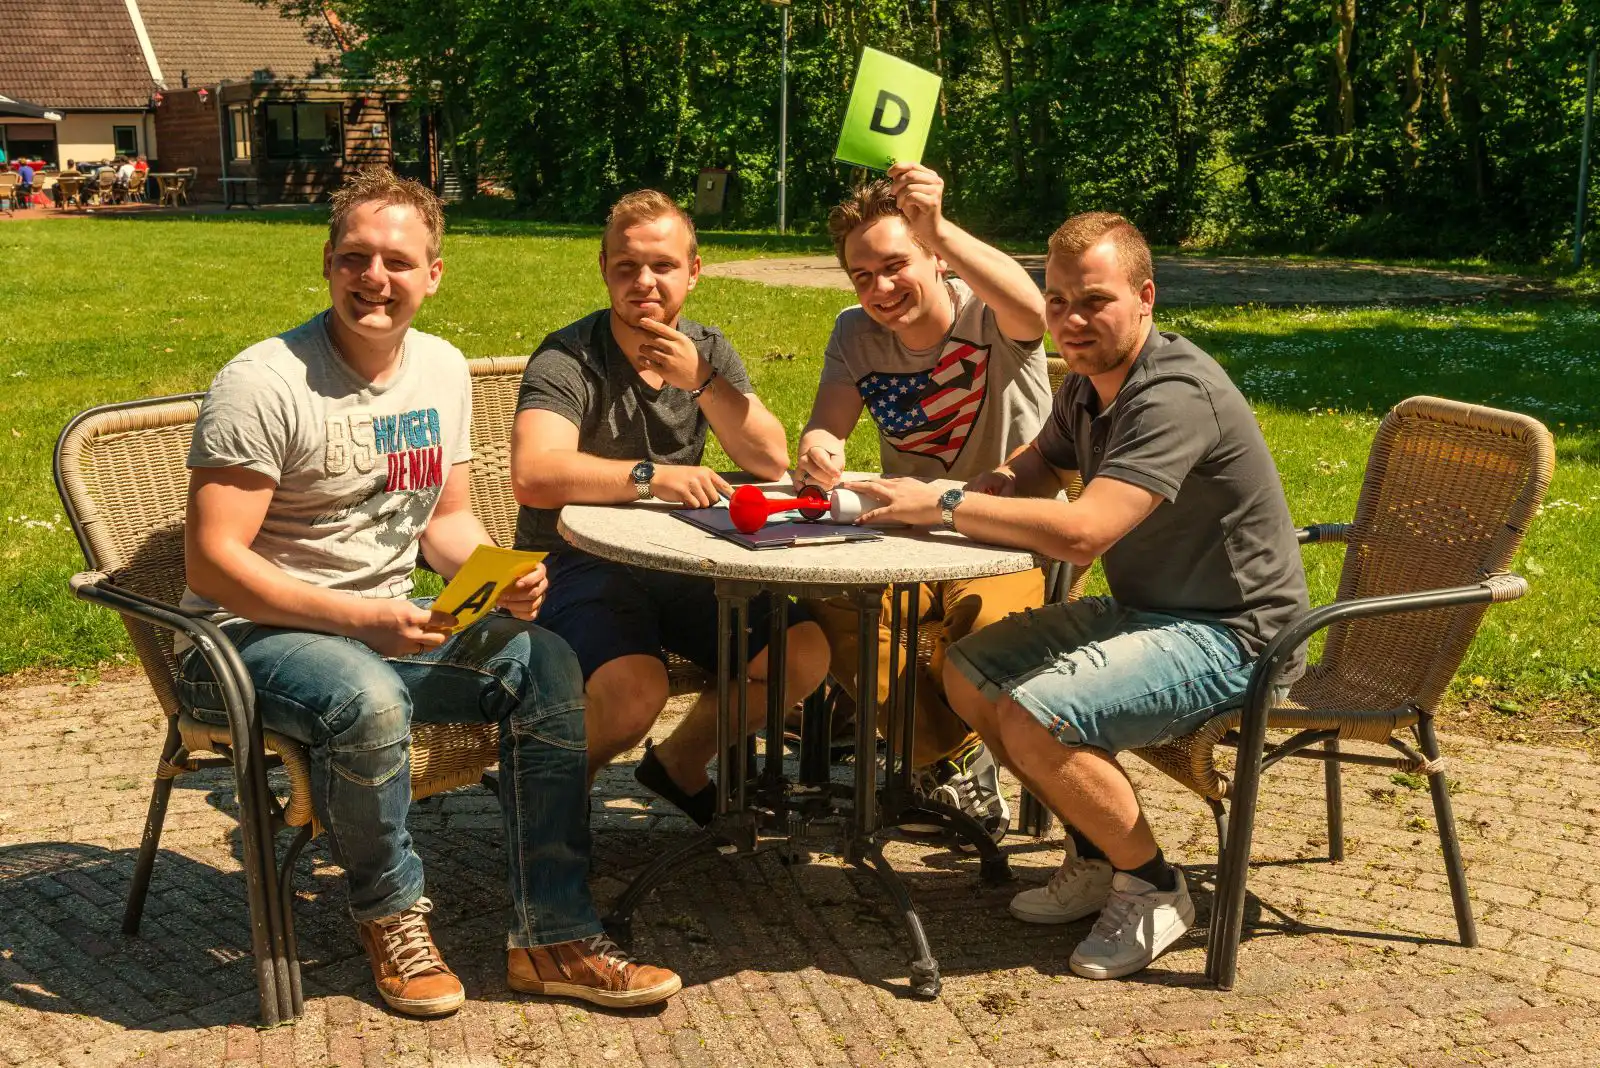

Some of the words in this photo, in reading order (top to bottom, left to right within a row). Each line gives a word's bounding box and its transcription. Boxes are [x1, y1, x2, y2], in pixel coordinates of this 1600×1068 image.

[869, 89, 911, 136] D
[325, 414, 375, 474] 85
[384, 446, 443, 492] DENIM
[451, 581, 497, 616] A
